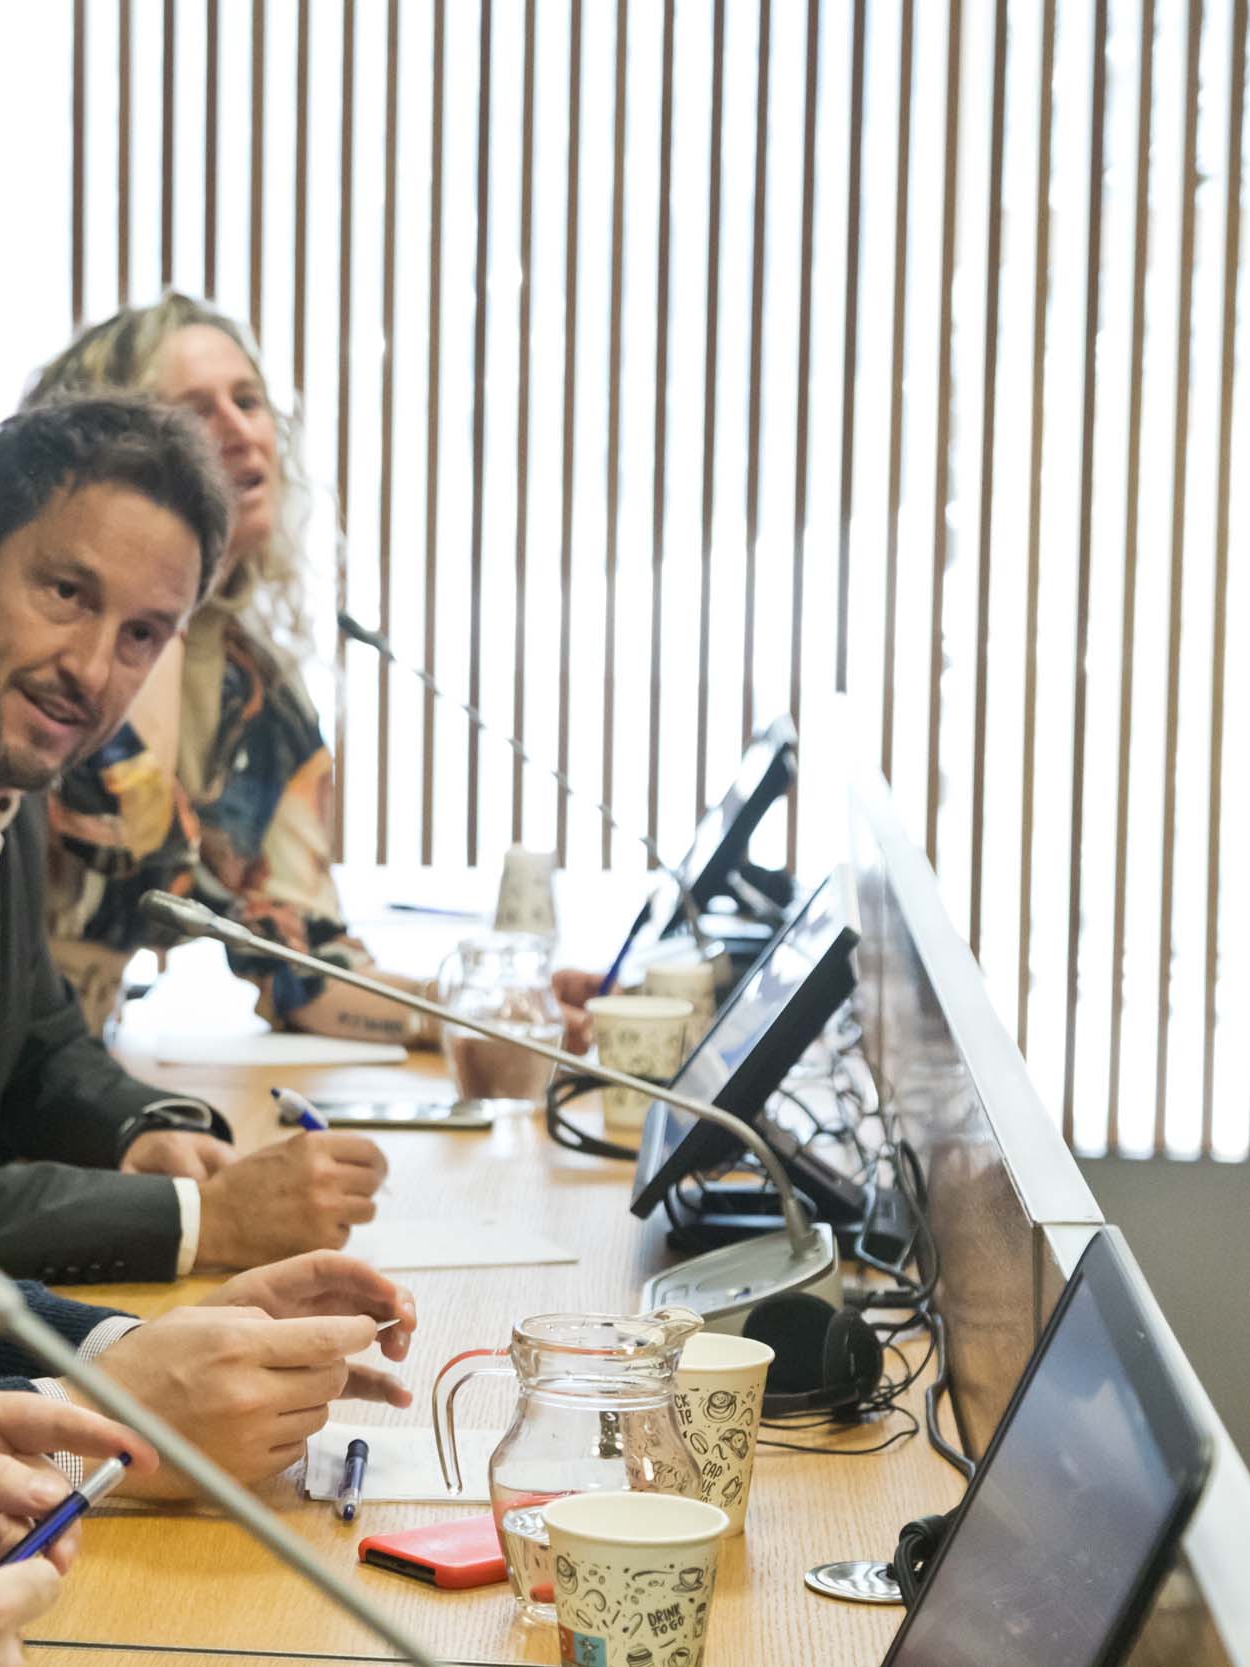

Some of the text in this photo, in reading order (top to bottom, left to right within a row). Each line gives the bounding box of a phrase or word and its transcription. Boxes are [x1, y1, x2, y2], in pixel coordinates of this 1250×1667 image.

[702, 1460, 723, 1480] CAP
[647, 1602, 682, 1627] DRINK
[651, 1615, 685, 1638] TO GO
